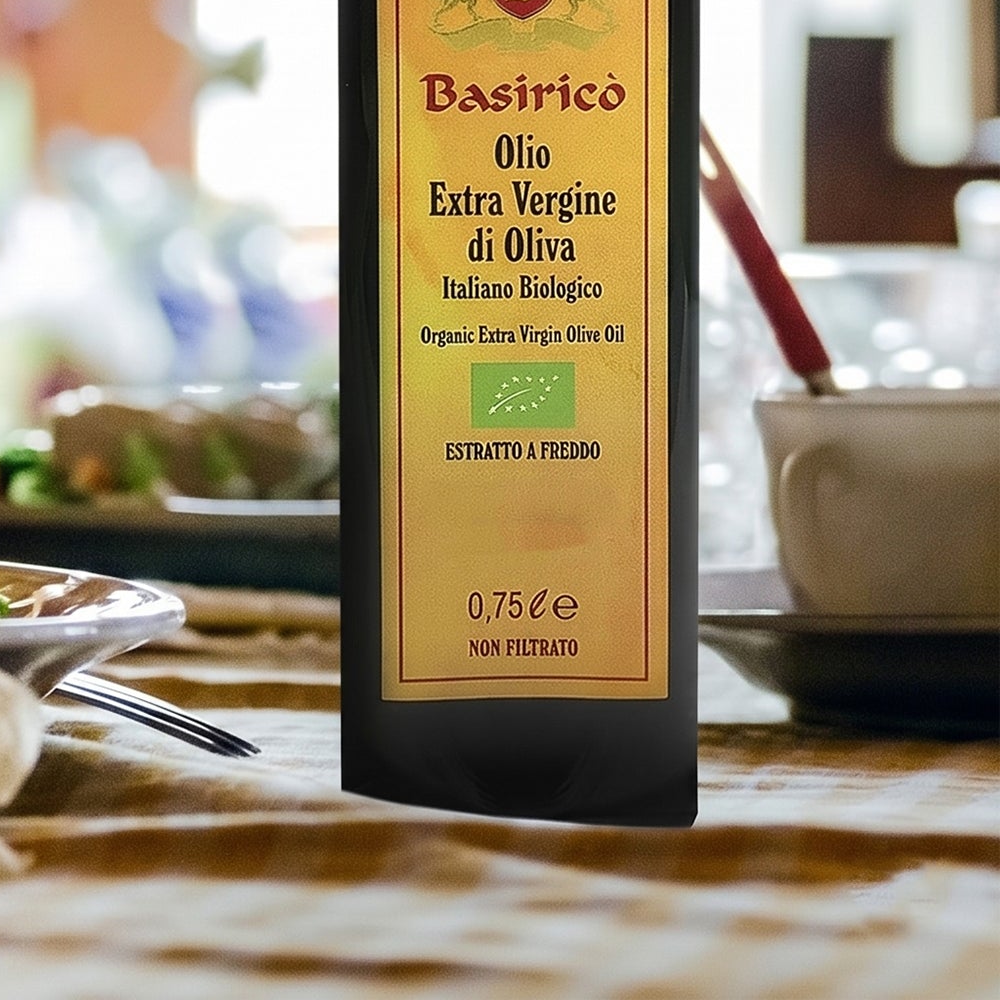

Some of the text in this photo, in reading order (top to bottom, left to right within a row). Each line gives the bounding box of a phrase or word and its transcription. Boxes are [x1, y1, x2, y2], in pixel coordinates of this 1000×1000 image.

[419, 72, 627, 112] Basiricò
[494, 134, 551, 169] Olio
[429, 181, 617, 223] Extra Vergine
[468, 227, 576, 262] di Oliva
[443, 276, 603, 303] Italiano Biologico
[420, 325, 625, 347] Organic Extra Virgin Olive Oil
[445, 442, 601, 460] ESTRATTO A FREDDO
[469, 639, 579, 657] NON FILTRATO
